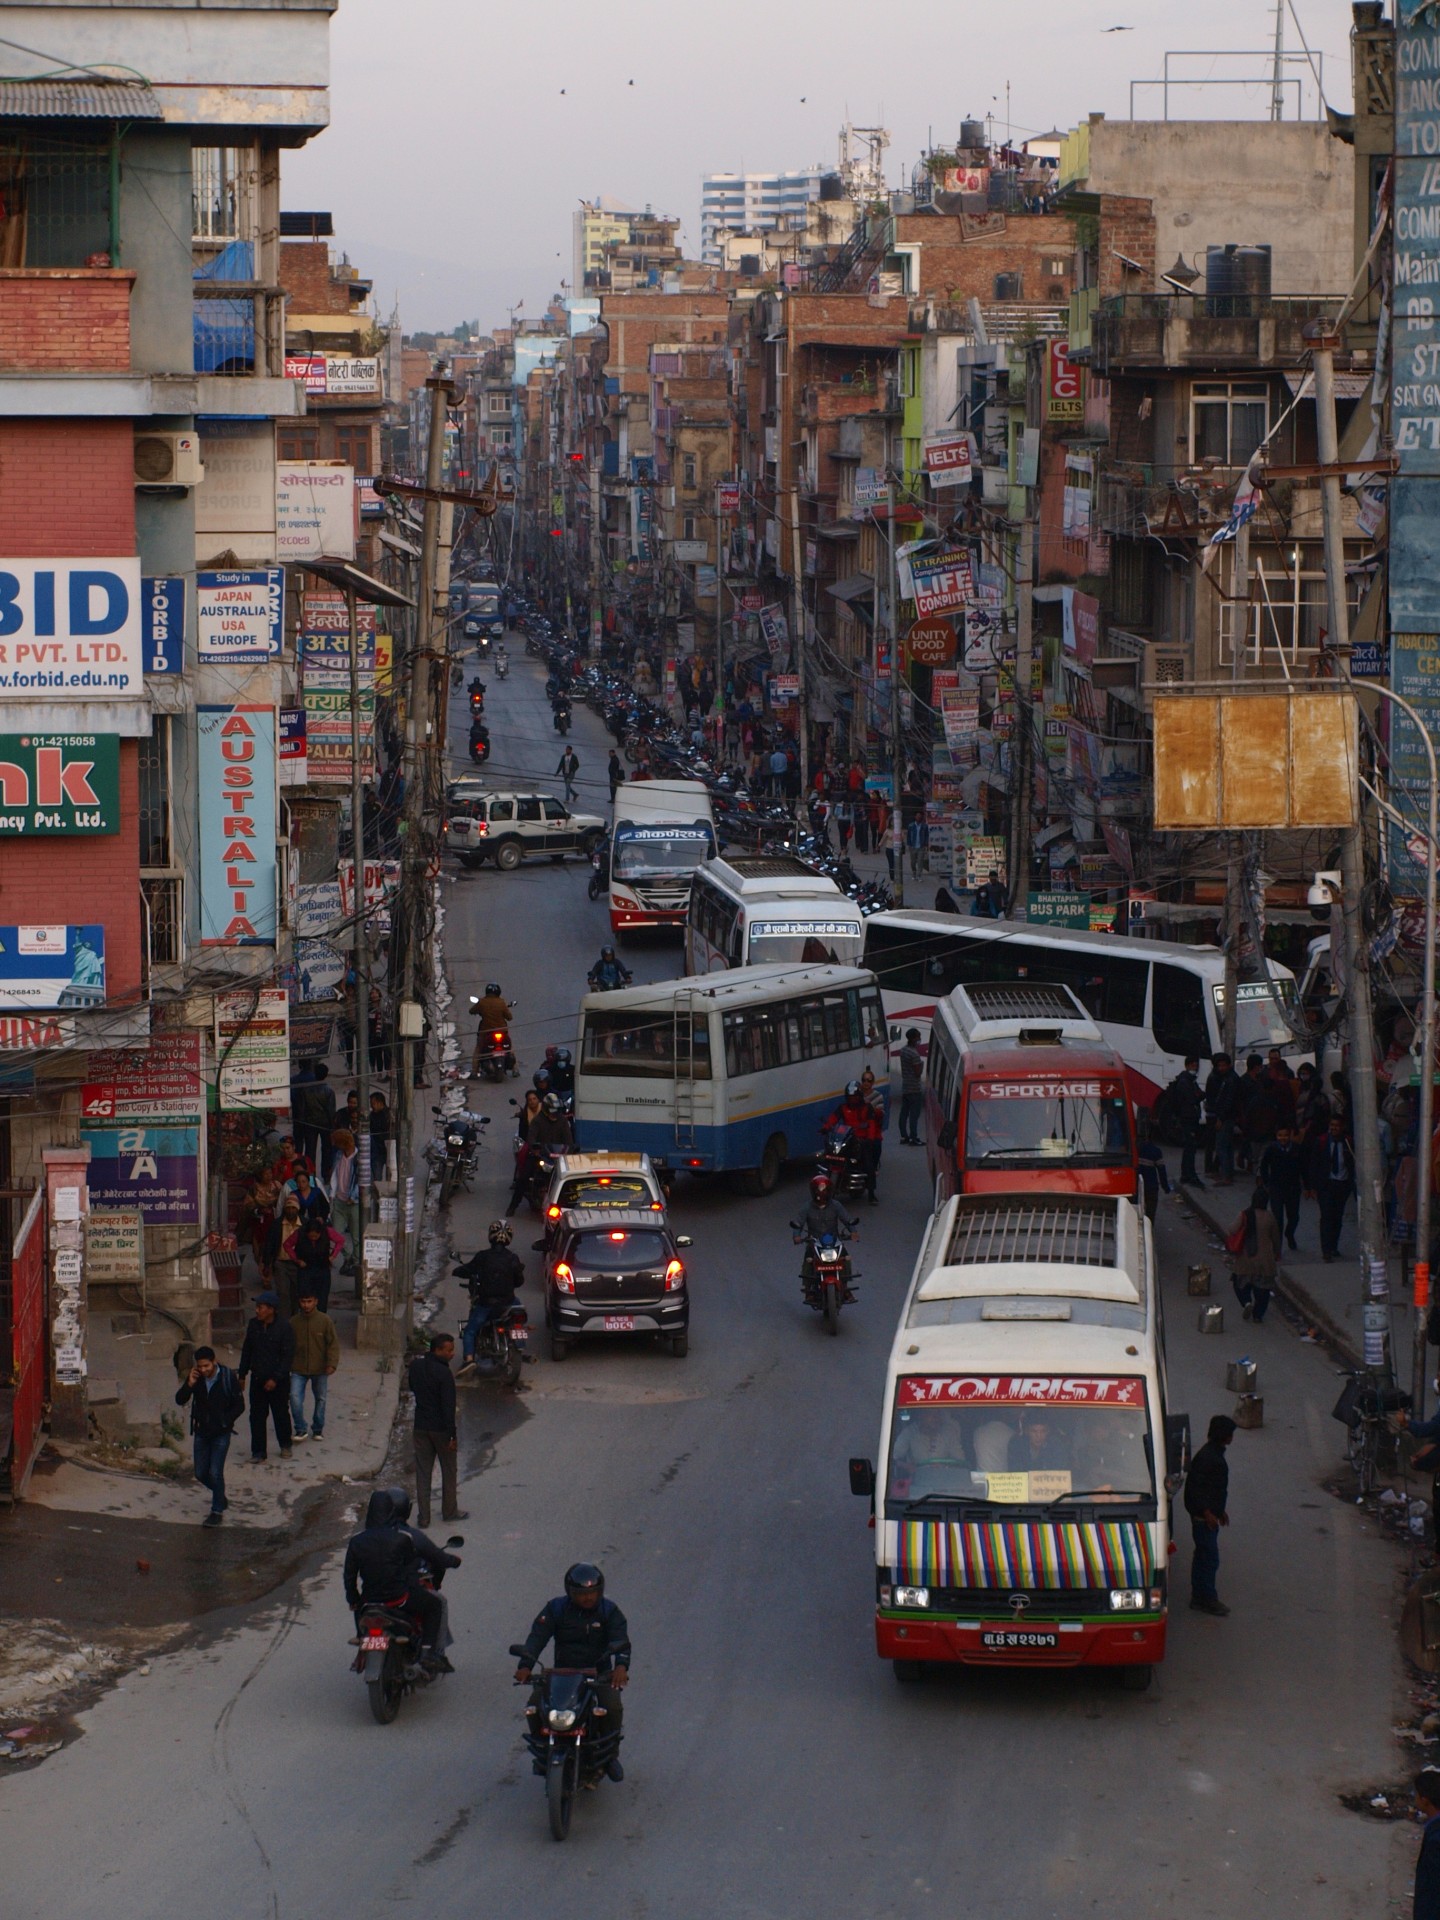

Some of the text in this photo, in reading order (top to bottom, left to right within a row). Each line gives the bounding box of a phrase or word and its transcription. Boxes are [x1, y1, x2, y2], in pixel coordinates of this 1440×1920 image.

[328, 361, 350, 379] नोटरी
[1393, 385, 1421, 408] SAT
[1050, 401, 1083, 412] IELTS
[928, 446, 969, 466] IELTS
[280, 474, 346, 488] सोसाइटी
[923, 551, 968, 567] TRAINING
[216, 573, 251, 583] Study in
[914, 570, 973, 599] LIFE
[214, 591, 253, 602] JAPAN
[200, 605, 267, 617] AUSTRALIA
[151, 579, 170, 672] FORBID
[221, 620, 246, 631] USA
[210, 634, 258, 646] EUROPE
[911, 629, 949, 641] UNITY
[1396, 633, 1440, 652] ABACUS
[16, 643, 68, 663] PVT.
[75, 643, 128, 663] LTD.
[911, 640, 946, 651] FOOD
[921, 652, 948, 662] CAFE
[1351, 661, 1382, 673] NOTARY
[1417, 656, 1440, 676] CE
[32, 736, 96, 747] 01-4215058
[34, 811, 67, 827] Pvt.
[75, 810, 107, 828] Ltd.
[220, 715, 259, 939] AUSTRALIA
[1037, 895, 1080, 904] BHAKTAPUR
[1030, 903, 1087, 916] BUS PARK
[132, 1085, 148, 1096] Self
[148, 1085, 160, 1095] Ink
[160, 1084, 185, 1097] Stamp
[185, 1083, 198, 1094] Etc
[989, 1082, 1102, 1099] SPORTAGE
[86, 1099, 113, 1116] 4G
[131, 1101, 151, 1114] Copy
[153, 1101, 160, 1110] &
[160, 1098, 200, 1114] Stationery
[625, 1096, 667, 1105] Mahindra
[129, 1156, 158, 1180] A
[925, 1377, 1119, 1400] TOURIST
